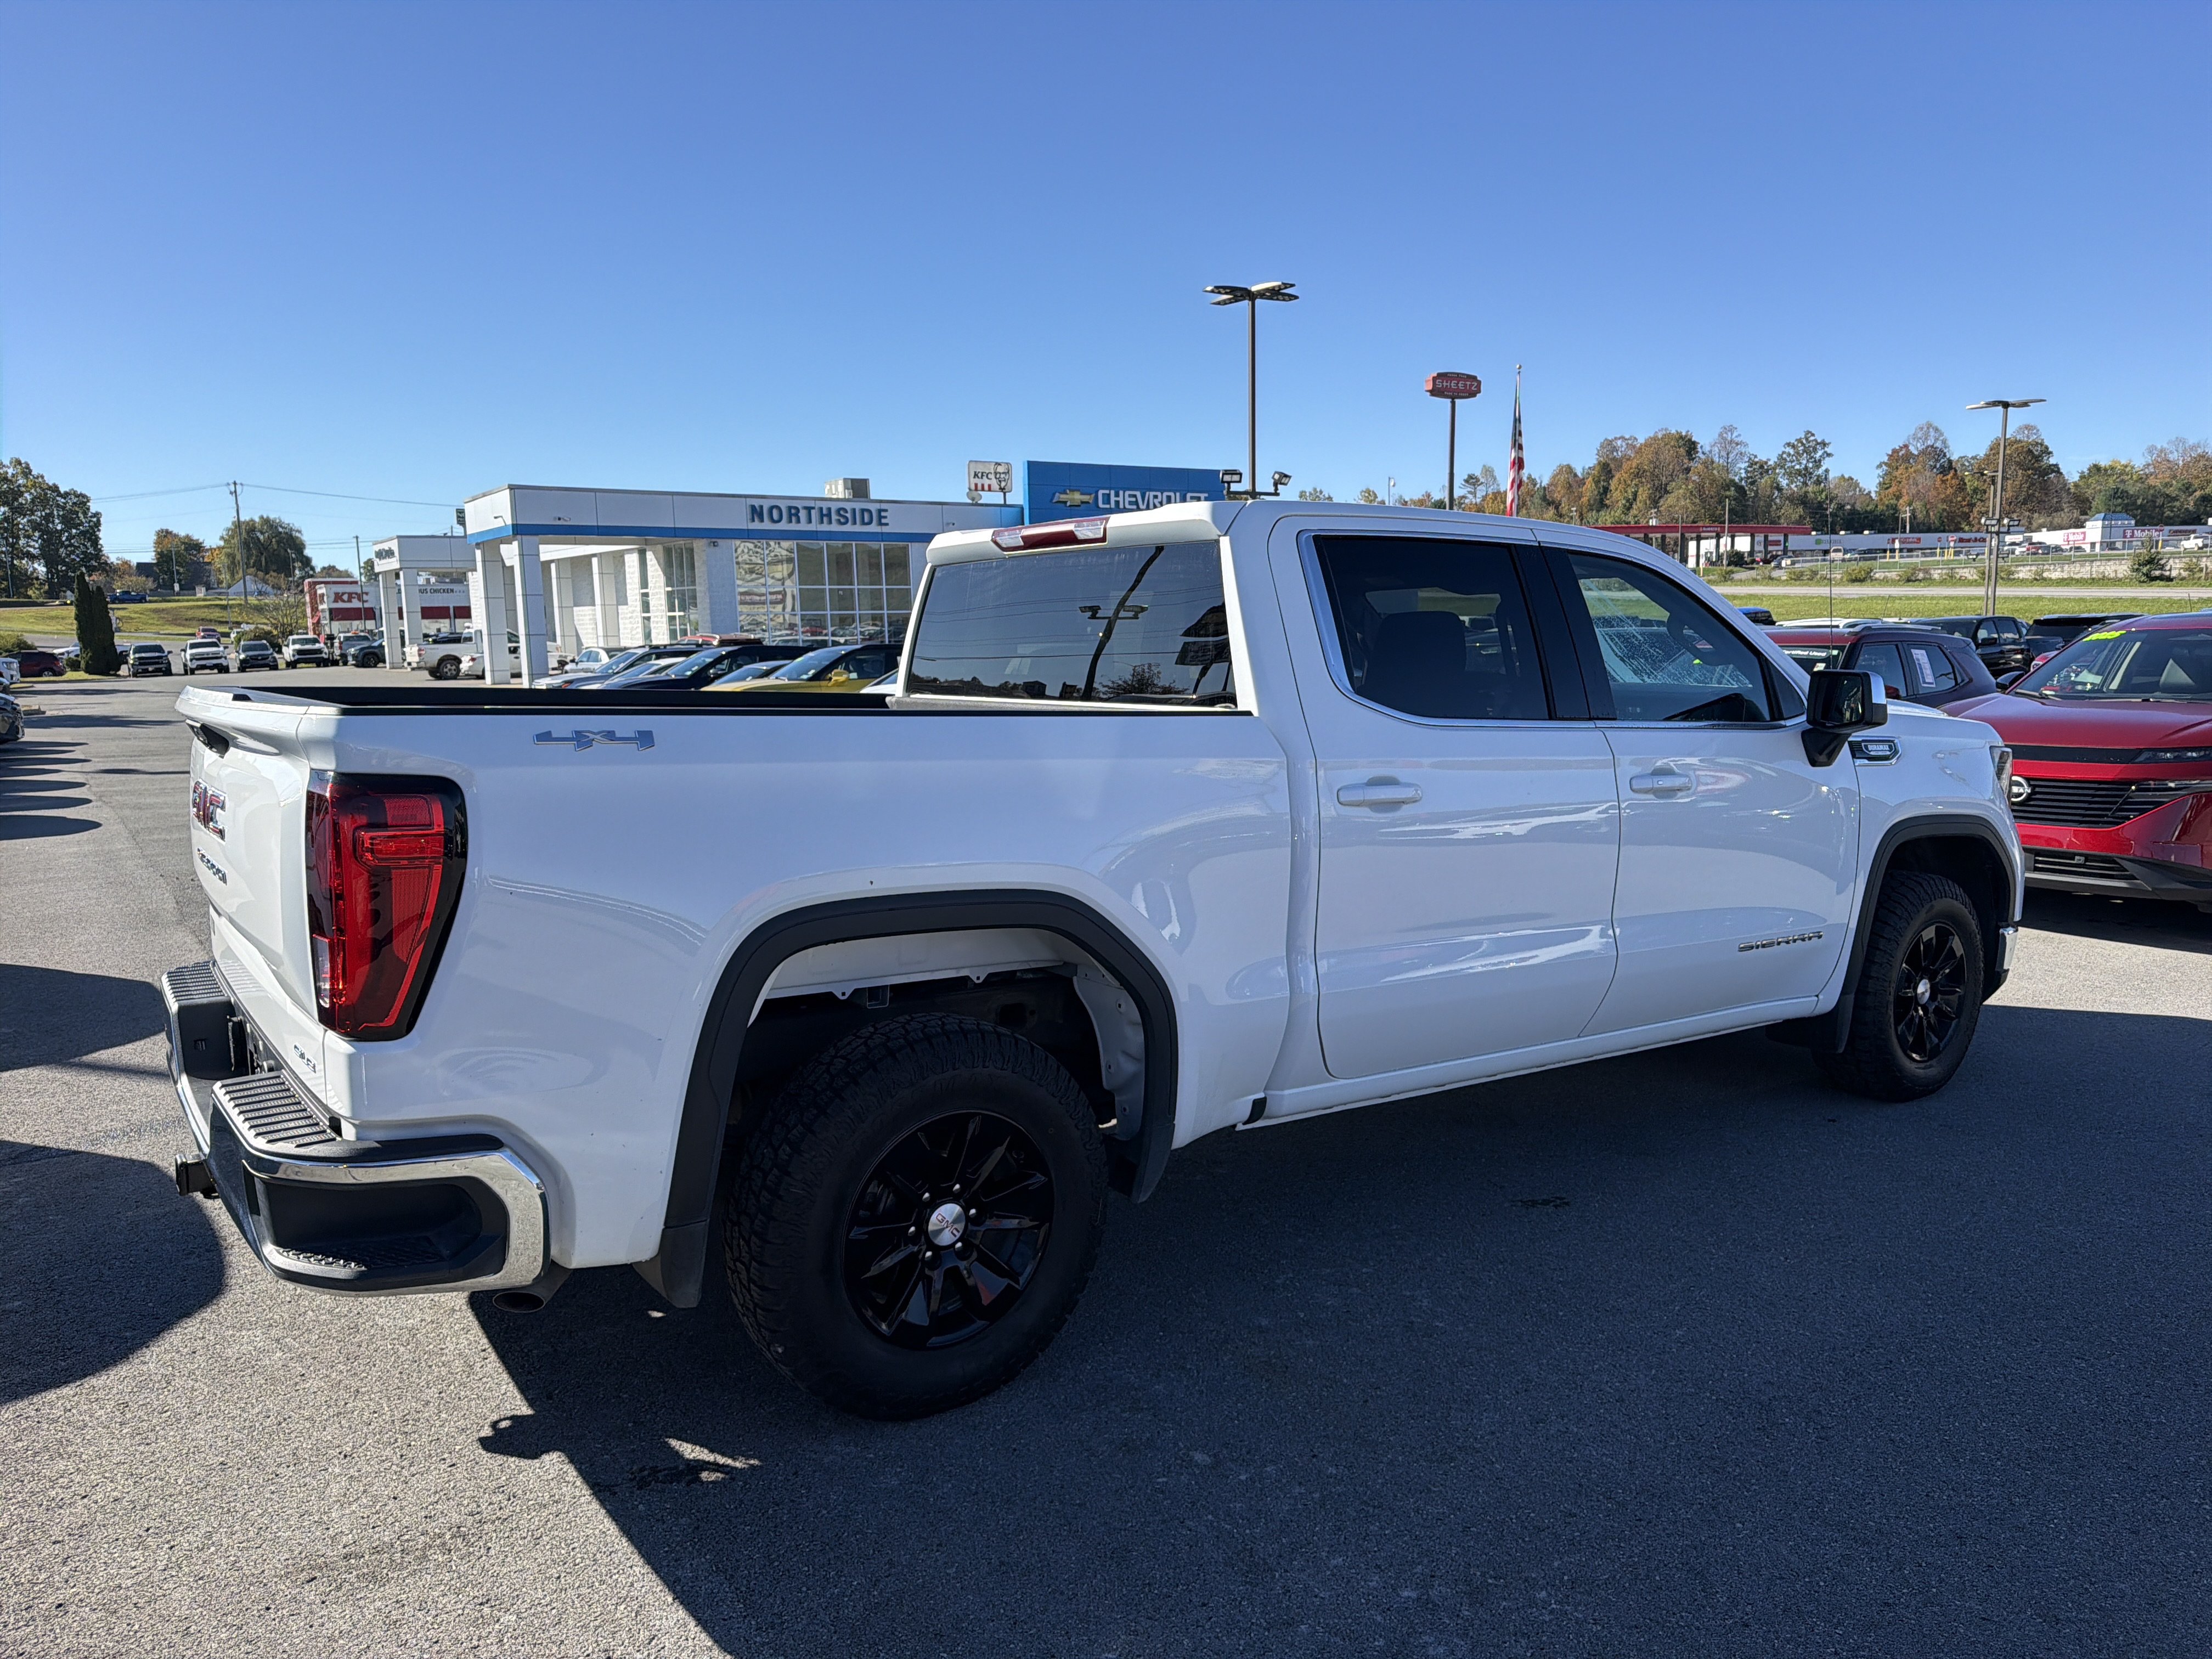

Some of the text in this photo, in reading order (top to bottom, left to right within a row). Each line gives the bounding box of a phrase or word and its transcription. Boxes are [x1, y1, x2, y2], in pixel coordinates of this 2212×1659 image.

[1436, 380, 1477, 390] SHEETZ
[973, 471, 992, 480] KFC
[748, 504, 889, 526] NORTHSIDE
[332, 592, 369, 603] KFC
[1738, 931, 1824, 952] SIERRA
[936, 1212, 960, 1238] GMC
